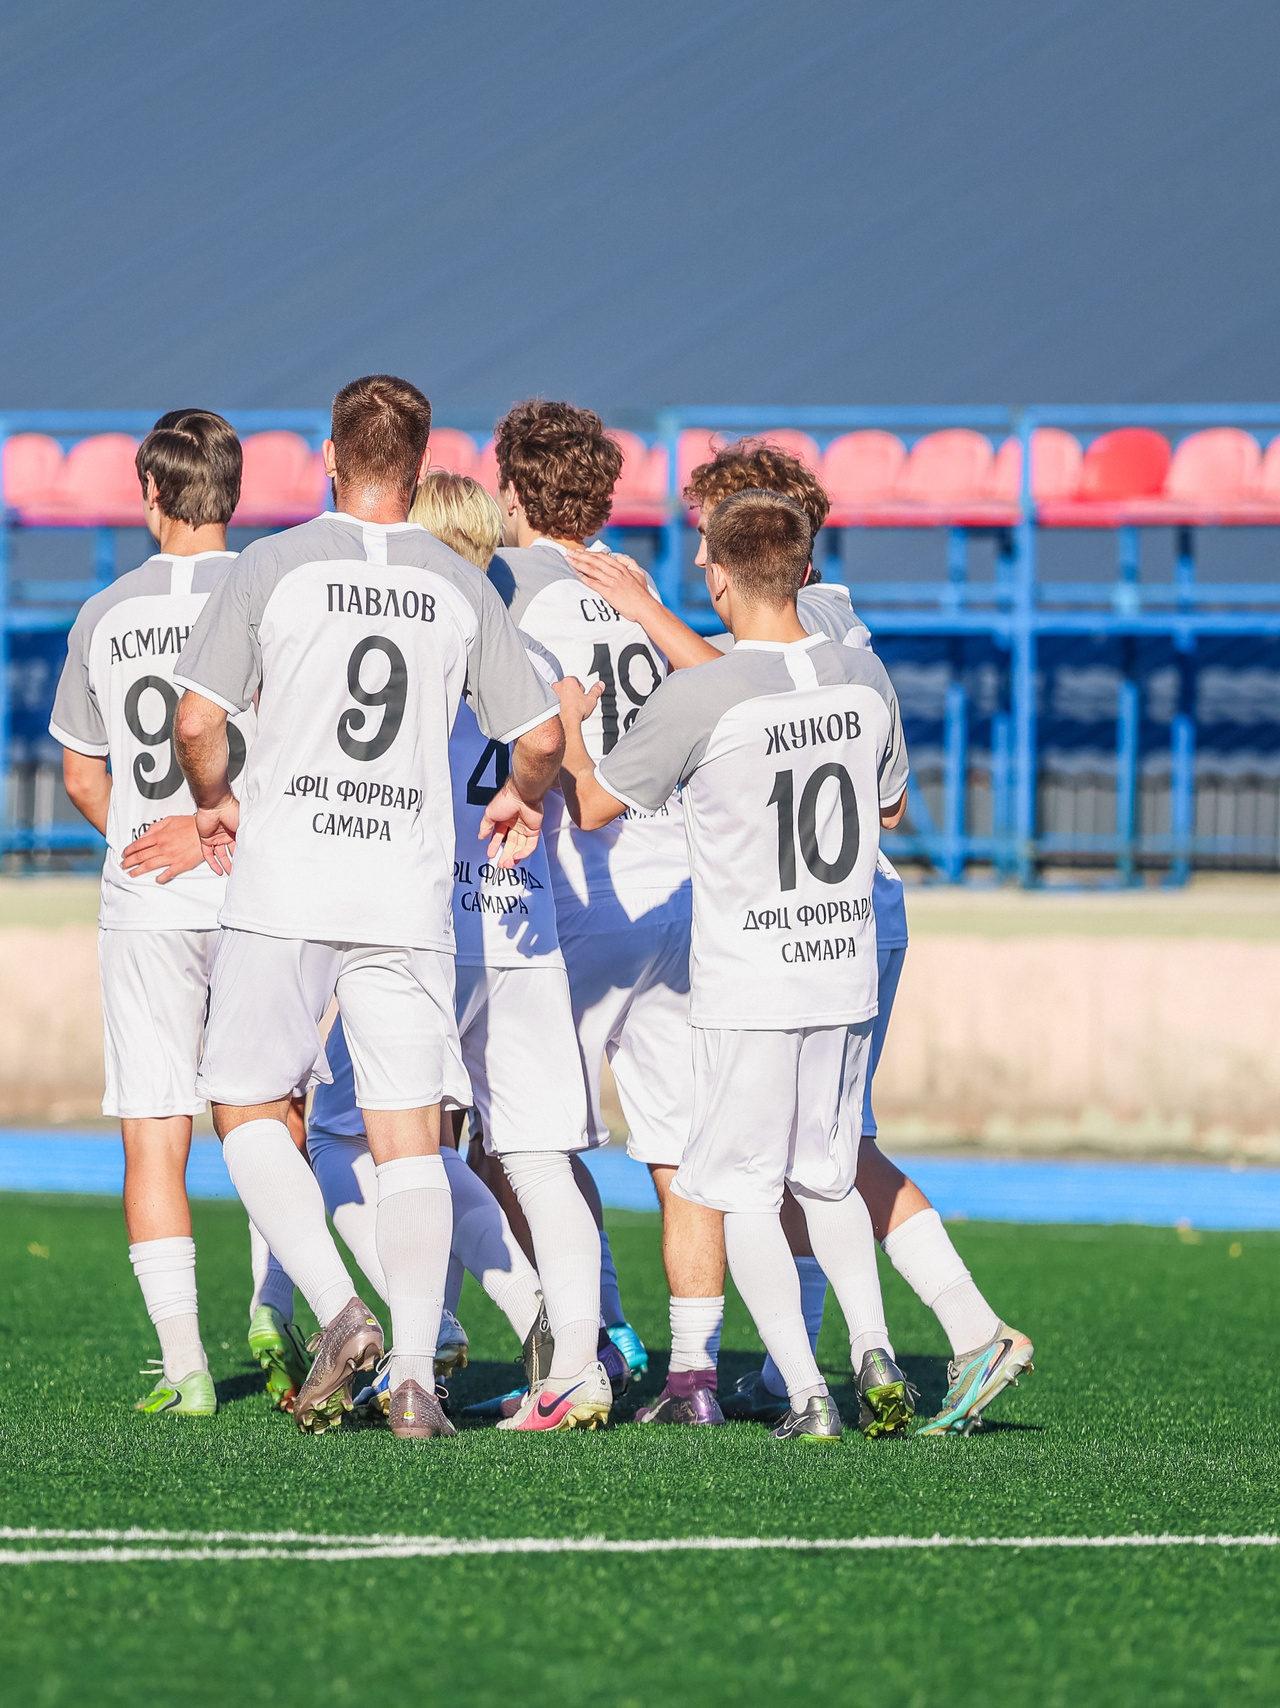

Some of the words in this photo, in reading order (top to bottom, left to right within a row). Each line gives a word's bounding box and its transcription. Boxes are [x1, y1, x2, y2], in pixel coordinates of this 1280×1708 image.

[326, 583, 436, 623] ПАВЛОВ
[110, 625, 195, 665] АСМИН
[337, 634, 408, 762] 9
[764, 710, 862, 756] ЖУКОВ
[312, 812, 392, 842] САМАРА
[765, 761, 860, 892] 10
[461, 890, 529, 915] САМАРА
[742, 907, 792, 931] ДФЦ
[781, 936, 857, 964] САМАРА
